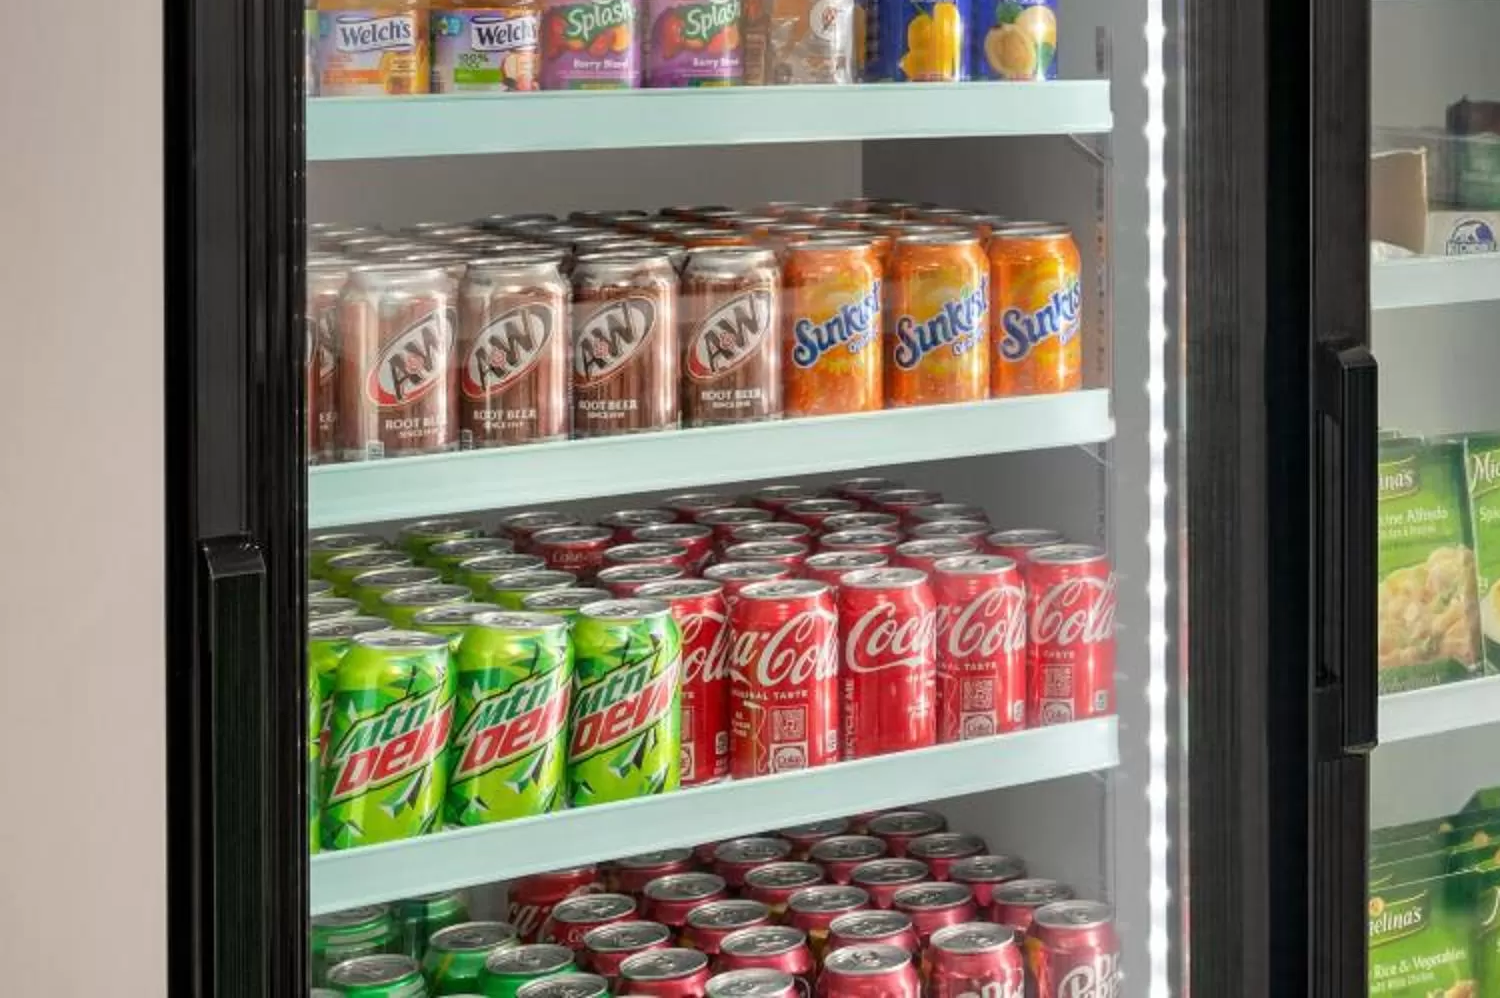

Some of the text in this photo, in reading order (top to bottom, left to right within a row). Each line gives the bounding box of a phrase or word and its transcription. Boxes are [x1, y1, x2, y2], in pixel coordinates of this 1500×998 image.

[340, 16, 411, 46] Welch's
[792, 278, 881, 368] Sunkist
[895, 274, 989, 369] Sunkist
[385, 418, 420, 430] ROOT
